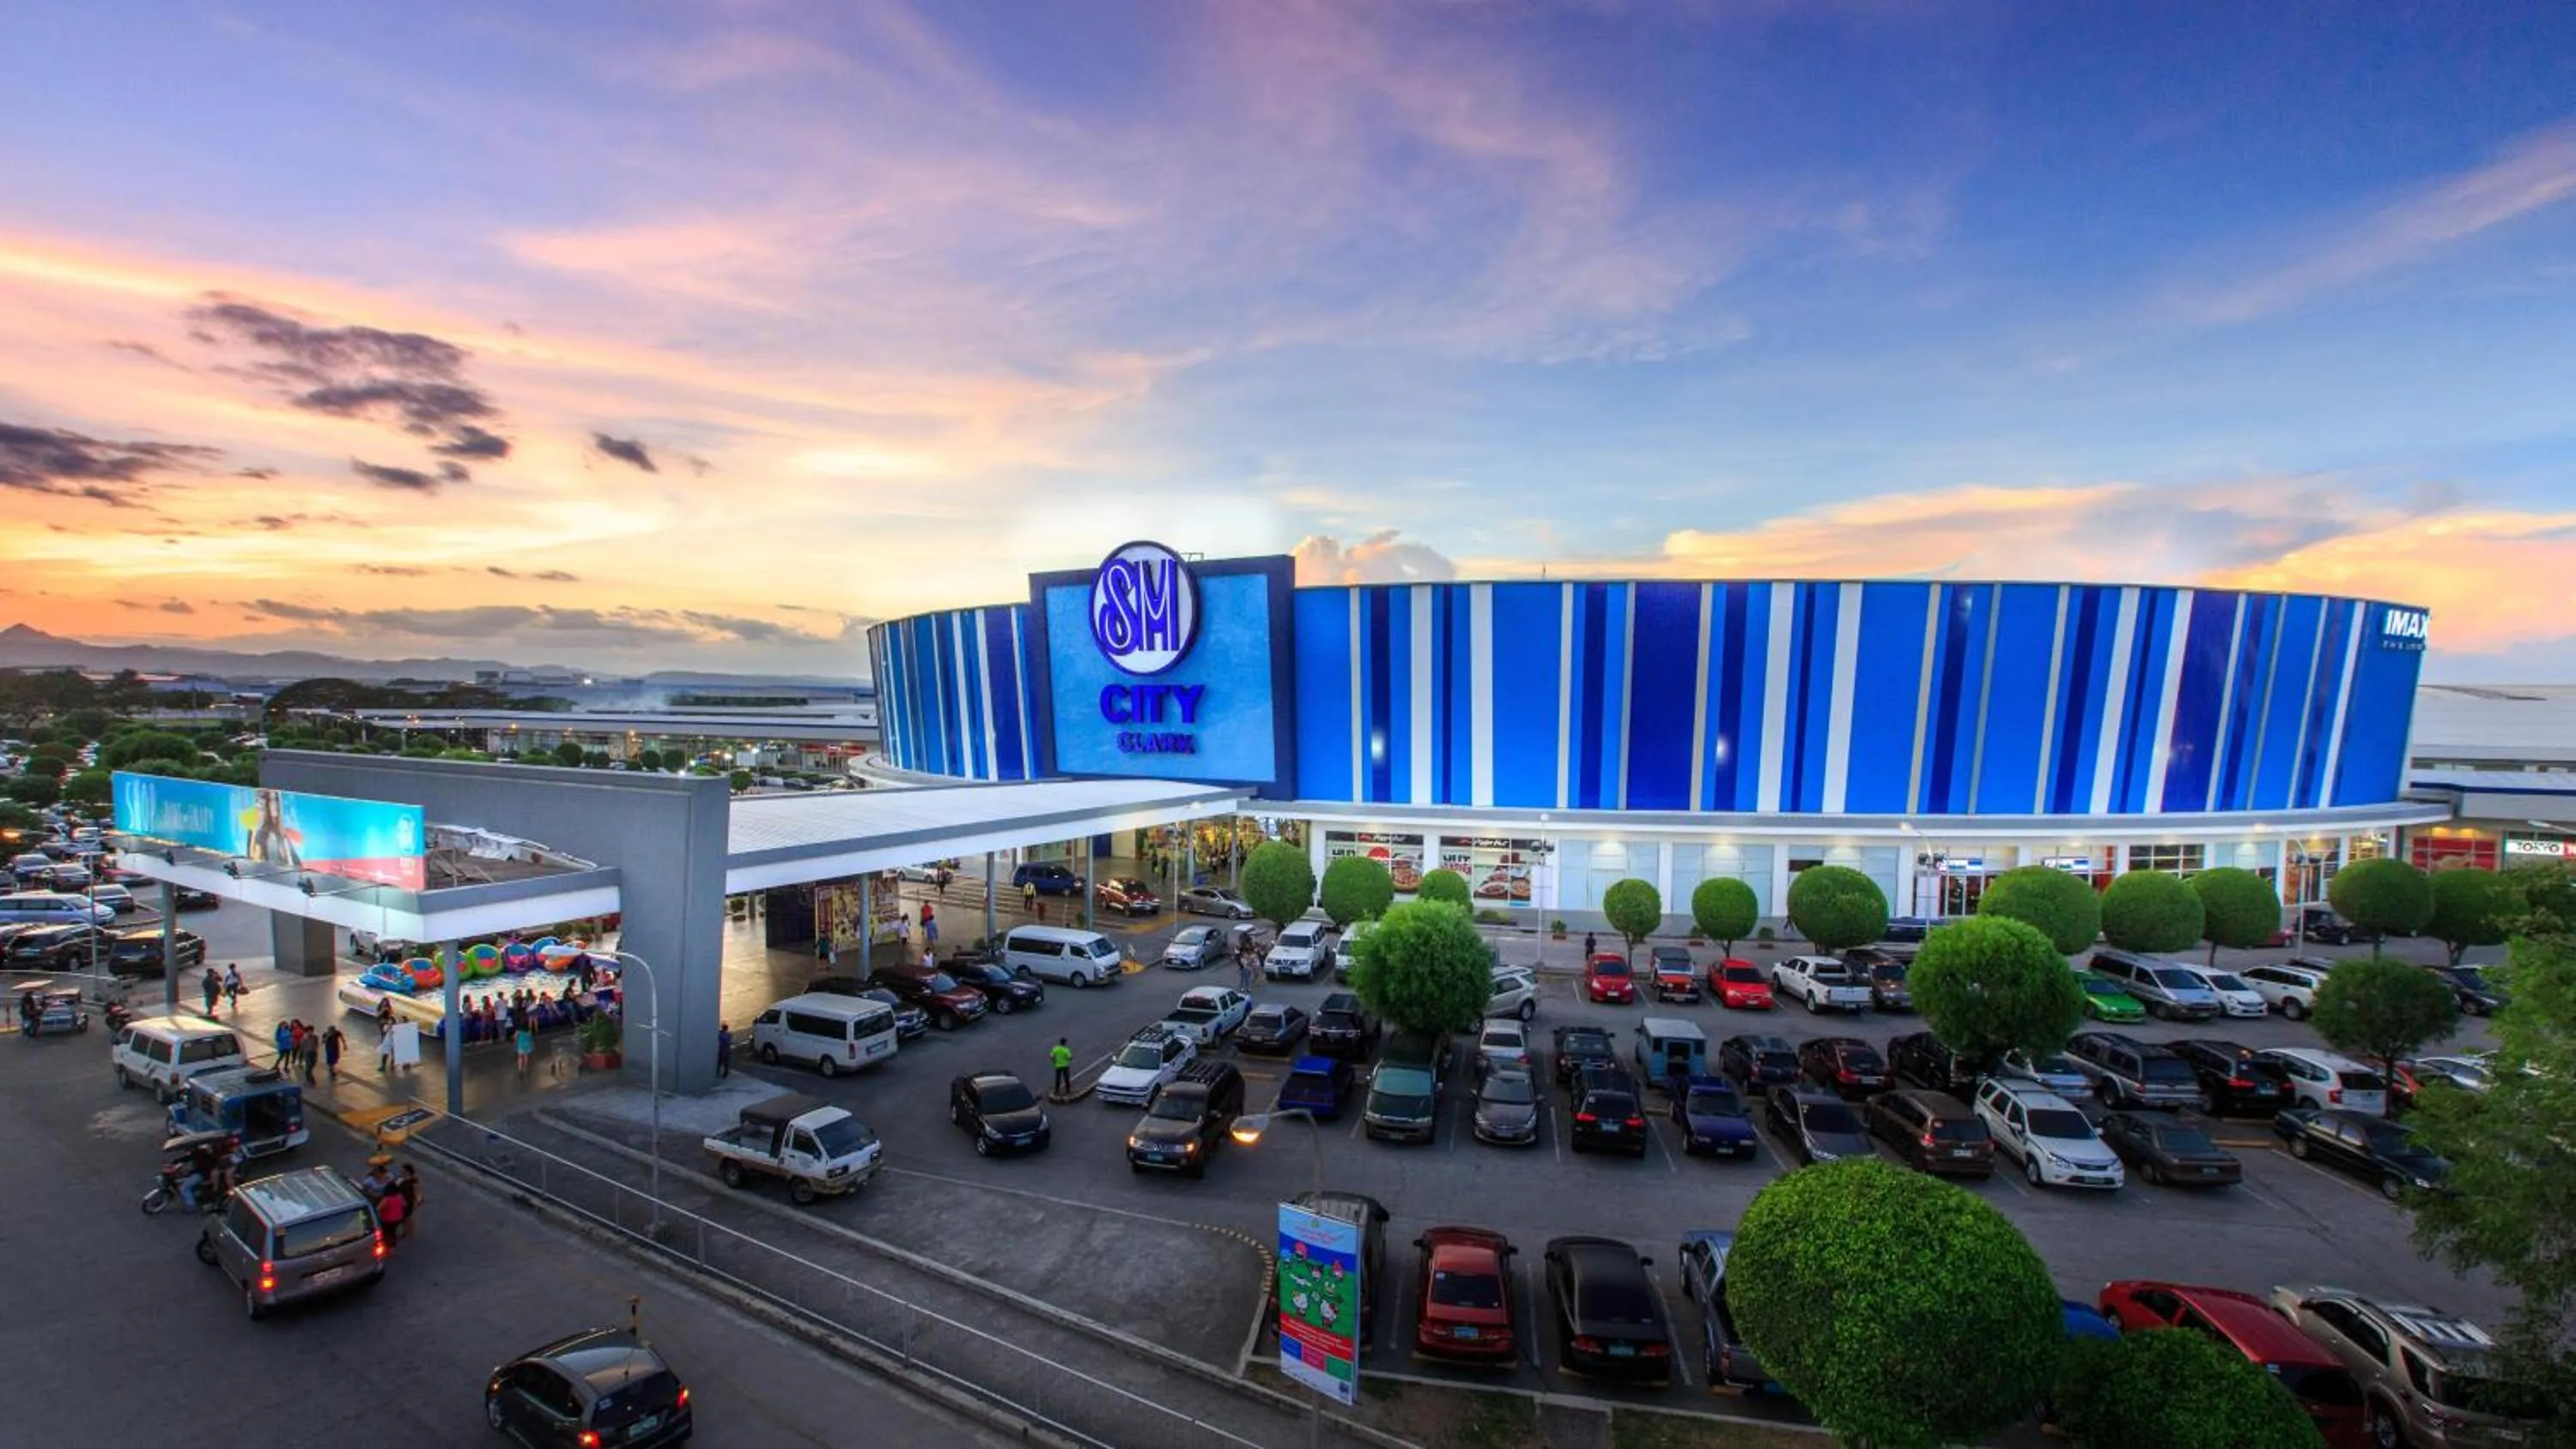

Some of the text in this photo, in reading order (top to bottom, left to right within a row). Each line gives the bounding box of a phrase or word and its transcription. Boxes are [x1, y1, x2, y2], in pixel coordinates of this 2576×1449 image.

[1098, 557, 1181, 657] SM
[2384, 609, 2429, 639] IMAX
[1098, 683, 1206, 724] CITY
[1116, 731, 1196, 755] CLARK
[2517, 841, 2560, 852] TOKYO
